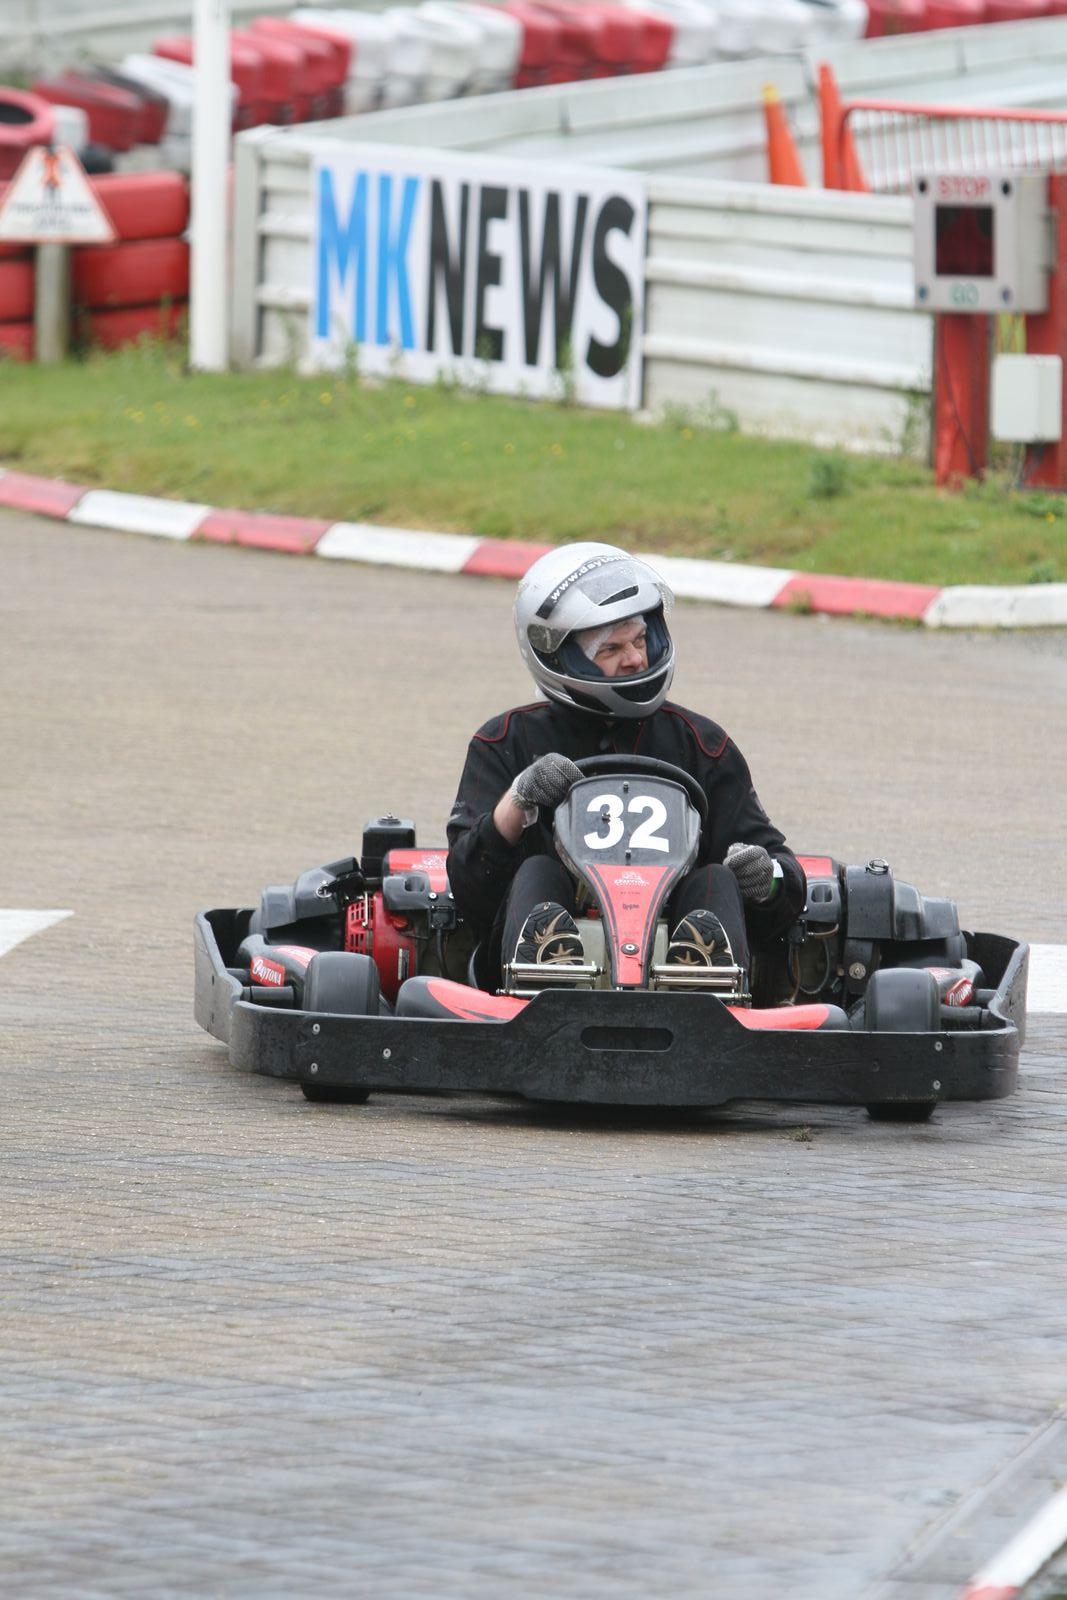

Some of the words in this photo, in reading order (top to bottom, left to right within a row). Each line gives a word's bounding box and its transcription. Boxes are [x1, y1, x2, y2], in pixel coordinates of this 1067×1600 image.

[937, 176, 990, 197] STOP
[949, 282, 979, 305] GO
[583, 793, 670, 853] 32
